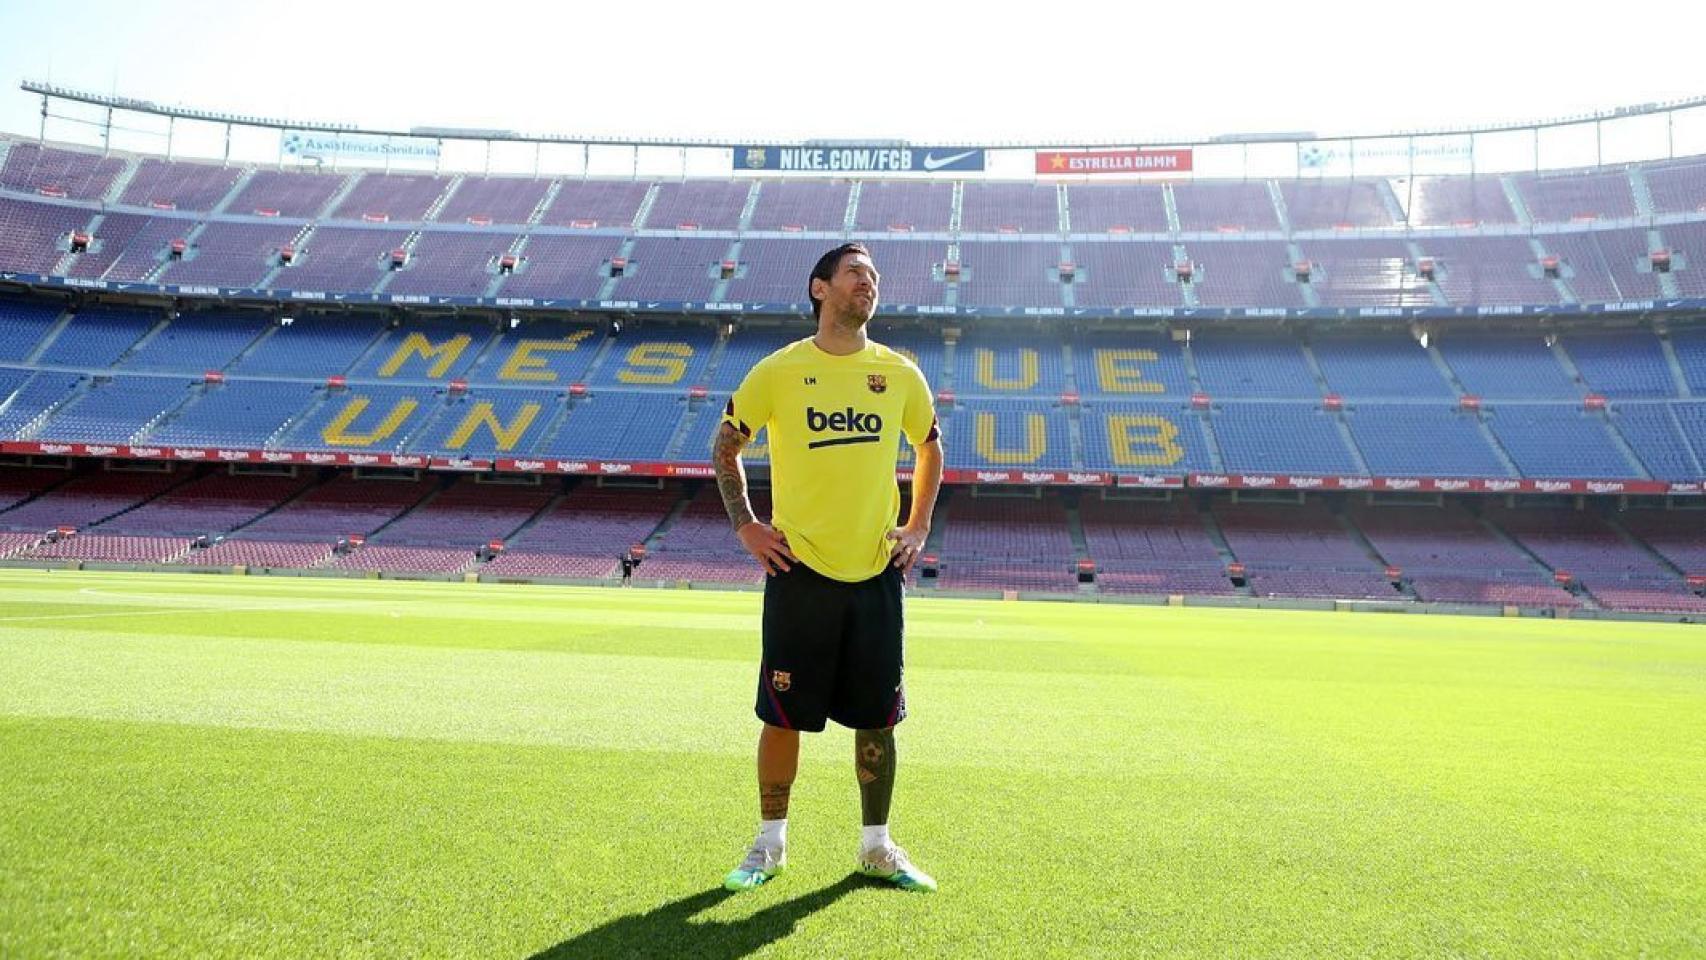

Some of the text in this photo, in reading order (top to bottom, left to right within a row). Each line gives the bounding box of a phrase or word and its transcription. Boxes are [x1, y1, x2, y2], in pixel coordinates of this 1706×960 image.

[780, 149, 912, 170] NIKE.COM/FCB
[1069, 154, 1177, 169] ESTRELLA DAMM
[806, 406, 882, 433] beko
